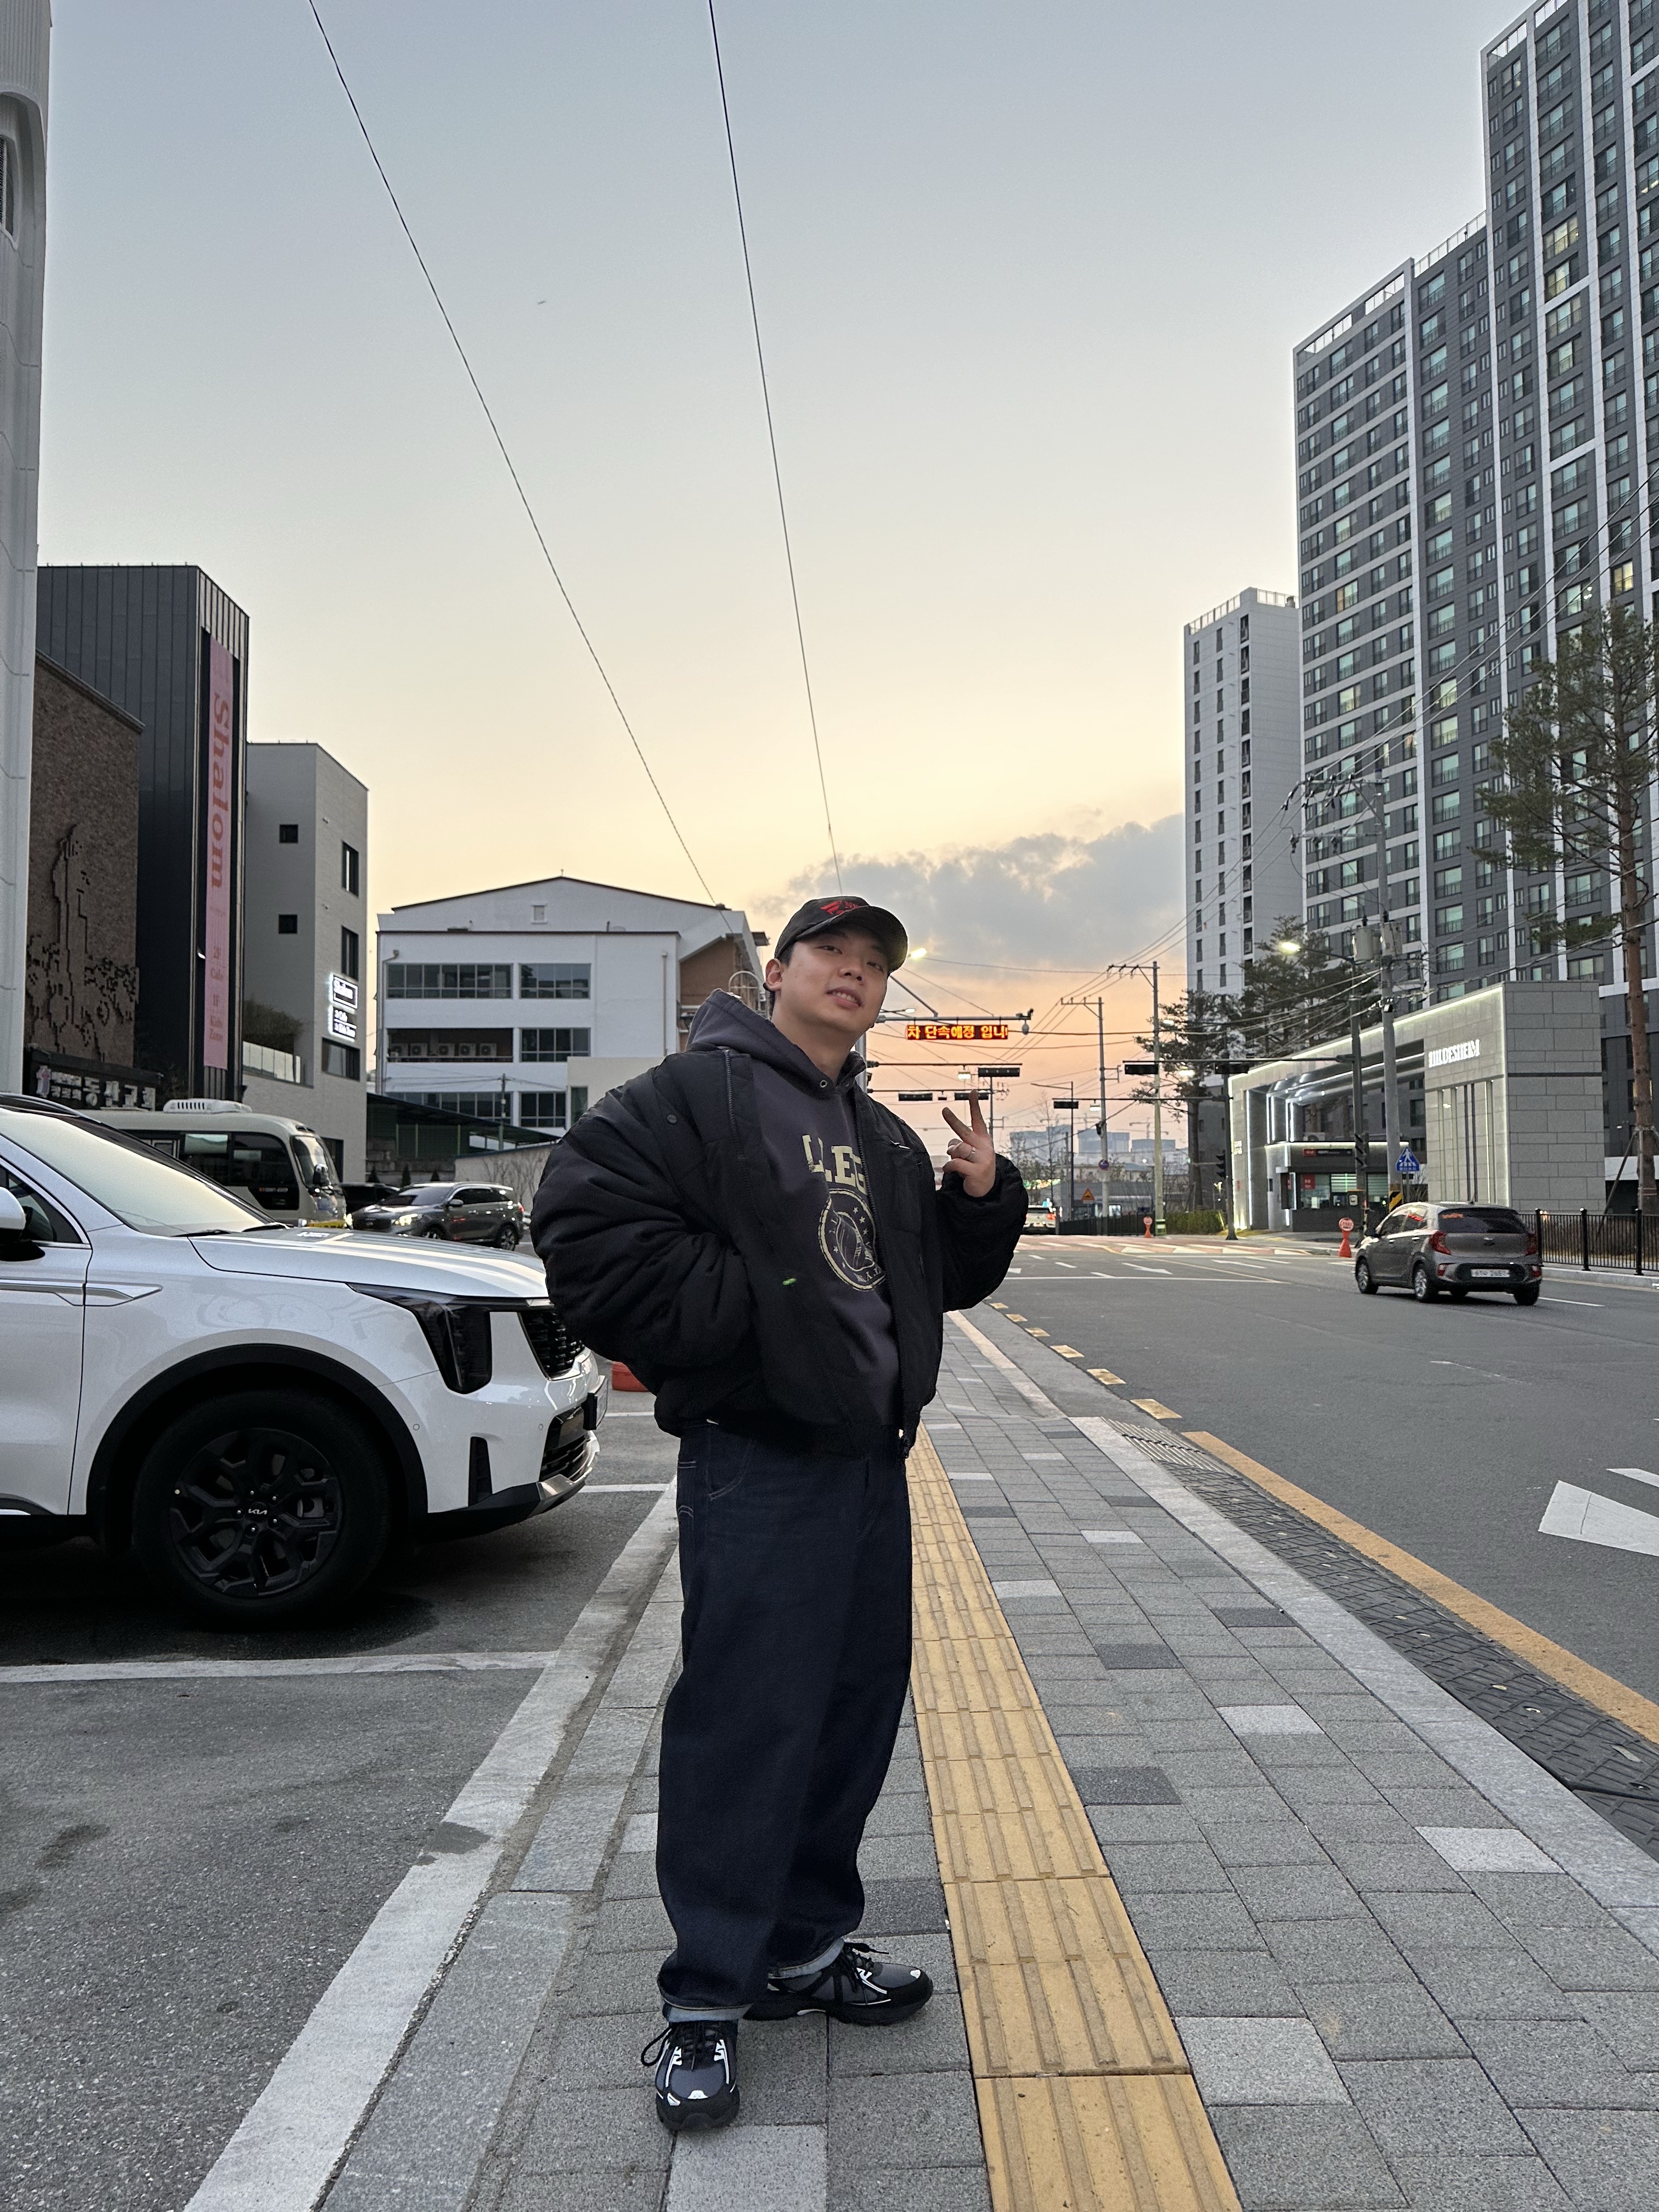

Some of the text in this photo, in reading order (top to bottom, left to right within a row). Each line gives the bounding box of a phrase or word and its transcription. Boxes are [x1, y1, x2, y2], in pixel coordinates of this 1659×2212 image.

[212, 692, 229, 888] Shalom
[908, 1025, 1008, 1039] 차 단속예정 입니
